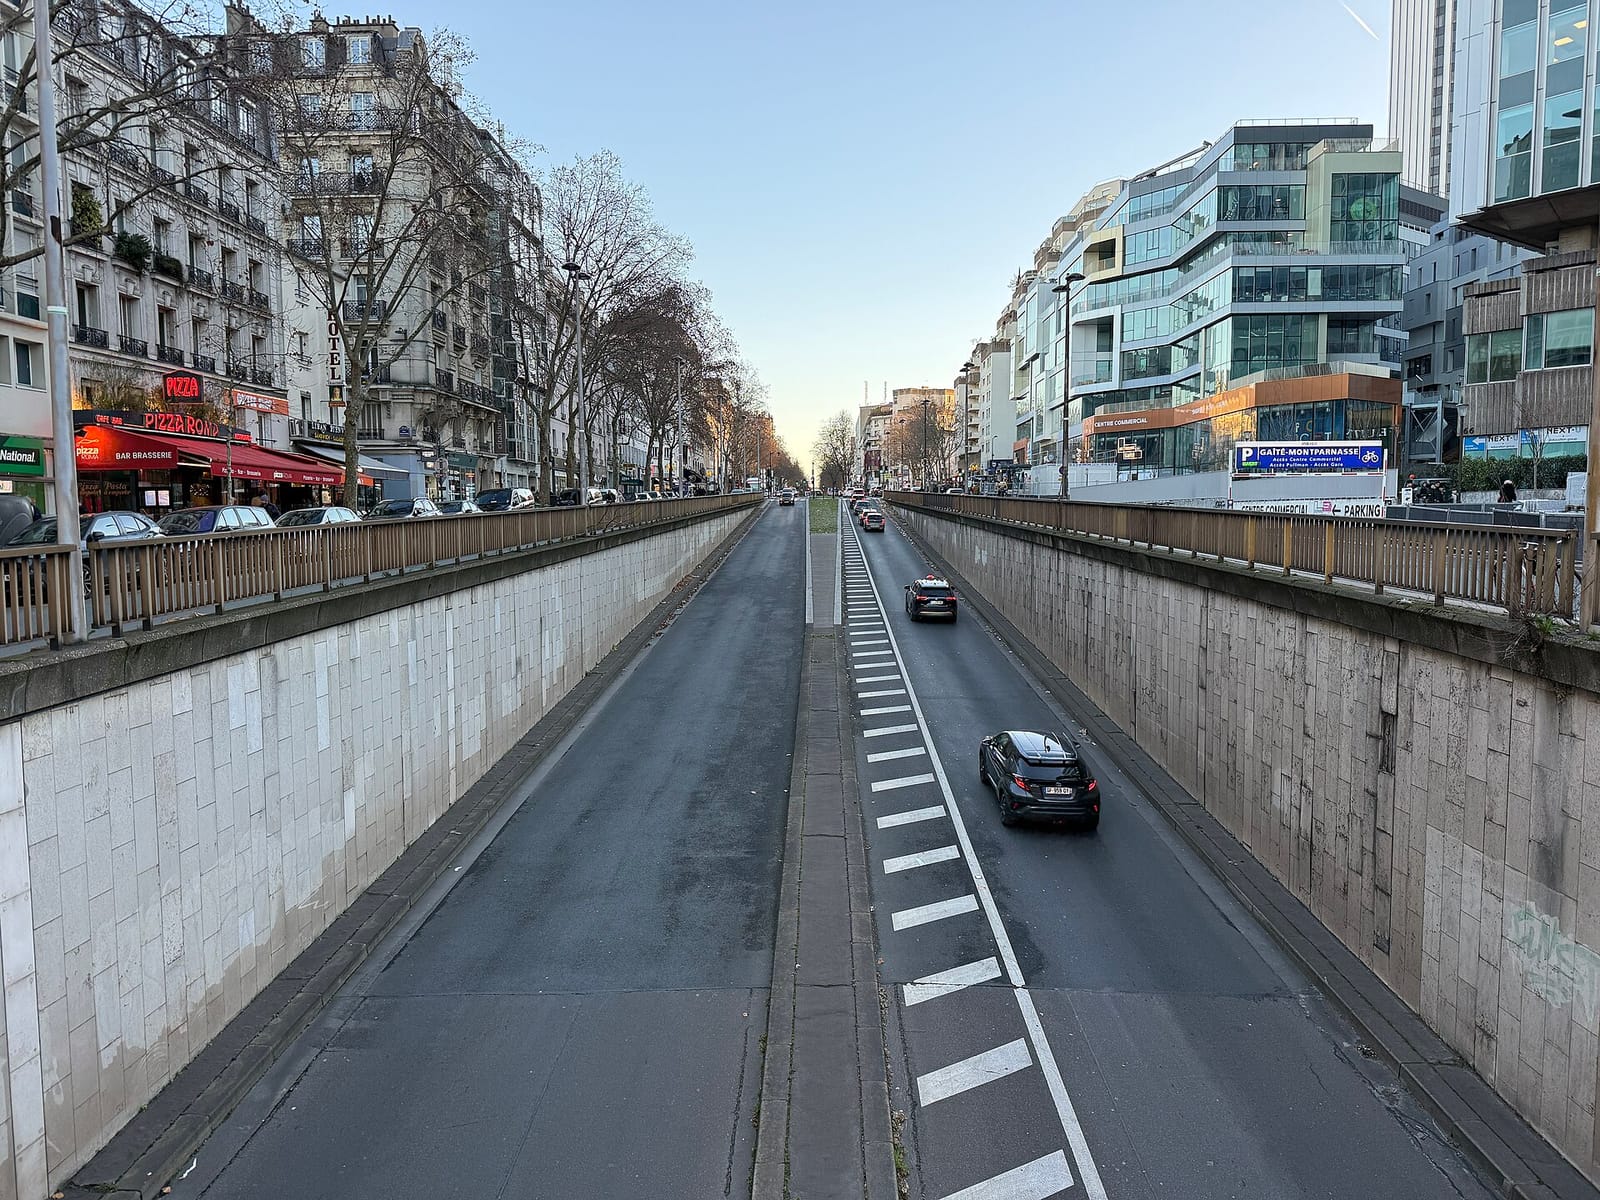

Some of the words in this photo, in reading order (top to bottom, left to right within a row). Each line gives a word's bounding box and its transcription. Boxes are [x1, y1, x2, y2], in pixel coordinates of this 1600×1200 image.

[166, 377, 199, 397] PIZZA
[145, 413, 184, 433] PIZZA
[1114, 418, 1148, 426] COMMERCIAL
[1463, 426, 1474, 434] 66
[76, 446, 98, 456] pizza
[1242, 448, 1254, 462] P
[1344, 504, 1380, 517] PARKING
